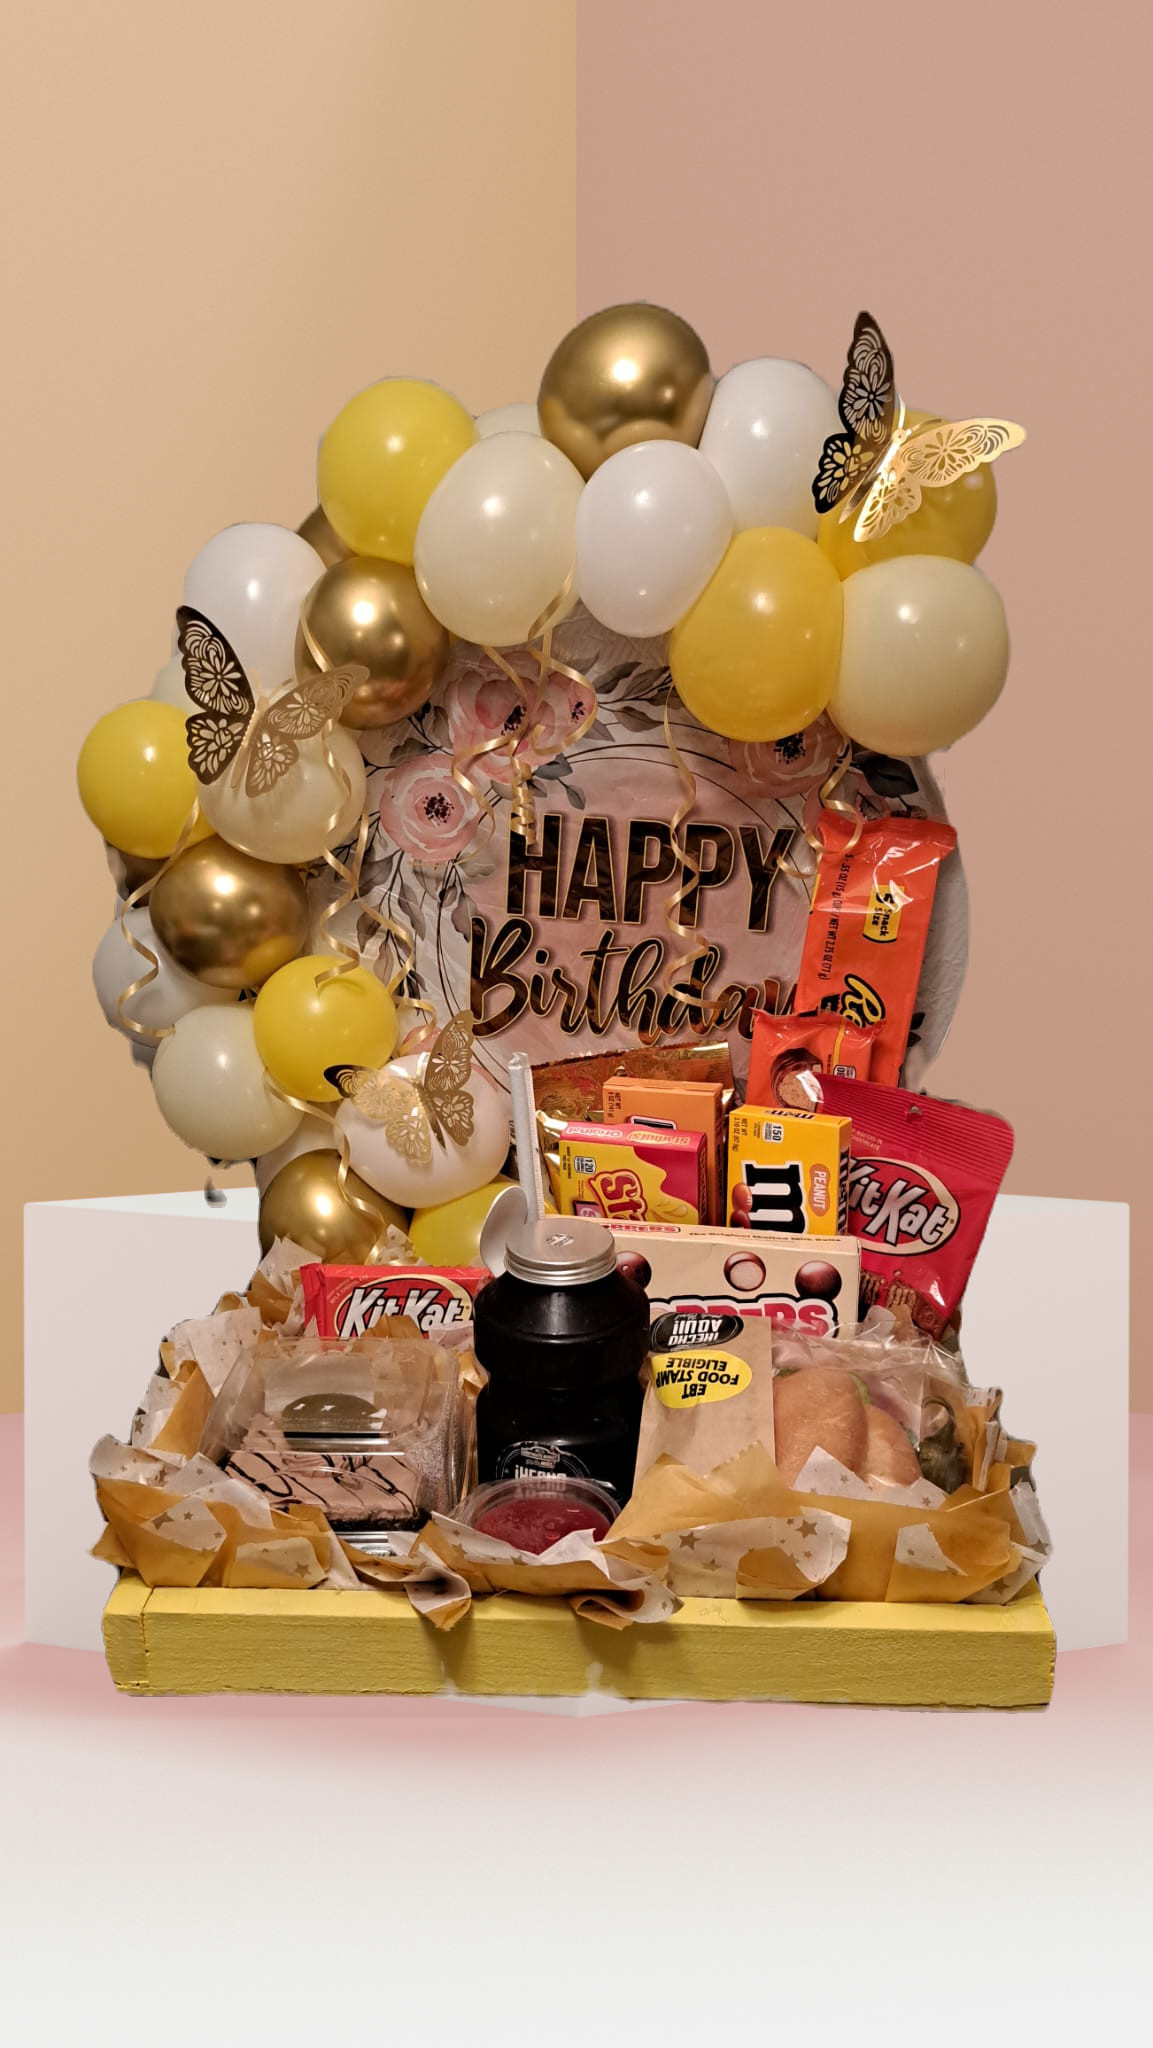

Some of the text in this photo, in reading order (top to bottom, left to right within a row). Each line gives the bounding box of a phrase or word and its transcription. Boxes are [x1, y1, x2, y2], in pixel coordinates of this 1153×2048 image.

[506, 812, 798, 932] HAPPY
[829, 918, 839, 930] NET
[871, 907, 882, 926] Size
[879, 908, 892, 936] Snack
[827, 930, 838, 941] WT
[772, 1124, 782, 1141] 150
[584, 1157, 595, 1173] 120
[813, 1169, 828, 1210] PEANUT
[672, 1319, 723, 1335] AQUI!
[666, 1357, 728, 1372] ELIGIBLE
[655, 1369, 740, 1388] FOOD STAMP
[681, 1383, 707, 1400] EBT
